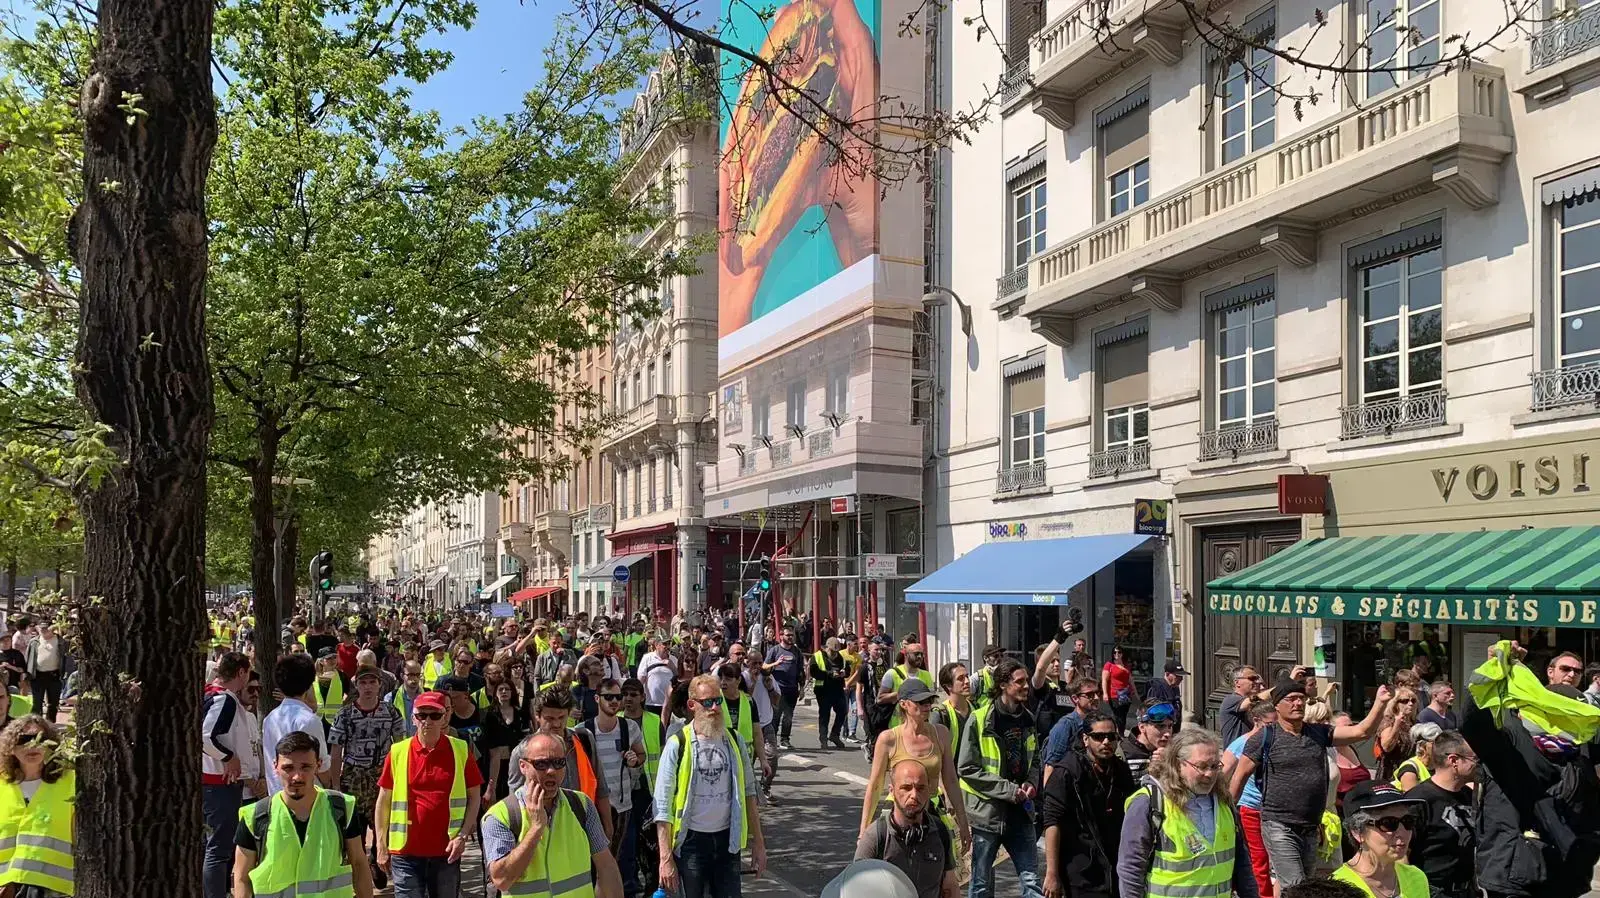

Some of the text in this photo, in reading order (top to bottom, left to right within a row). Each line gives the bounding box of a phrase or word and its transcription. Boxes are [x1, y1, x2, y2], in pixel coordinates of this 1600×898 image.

[1286, 495, 1326, 506] VOISIN
[1209, 593, 1598, 624] CHOCOLATS & SPÉCIALITÉS DE
